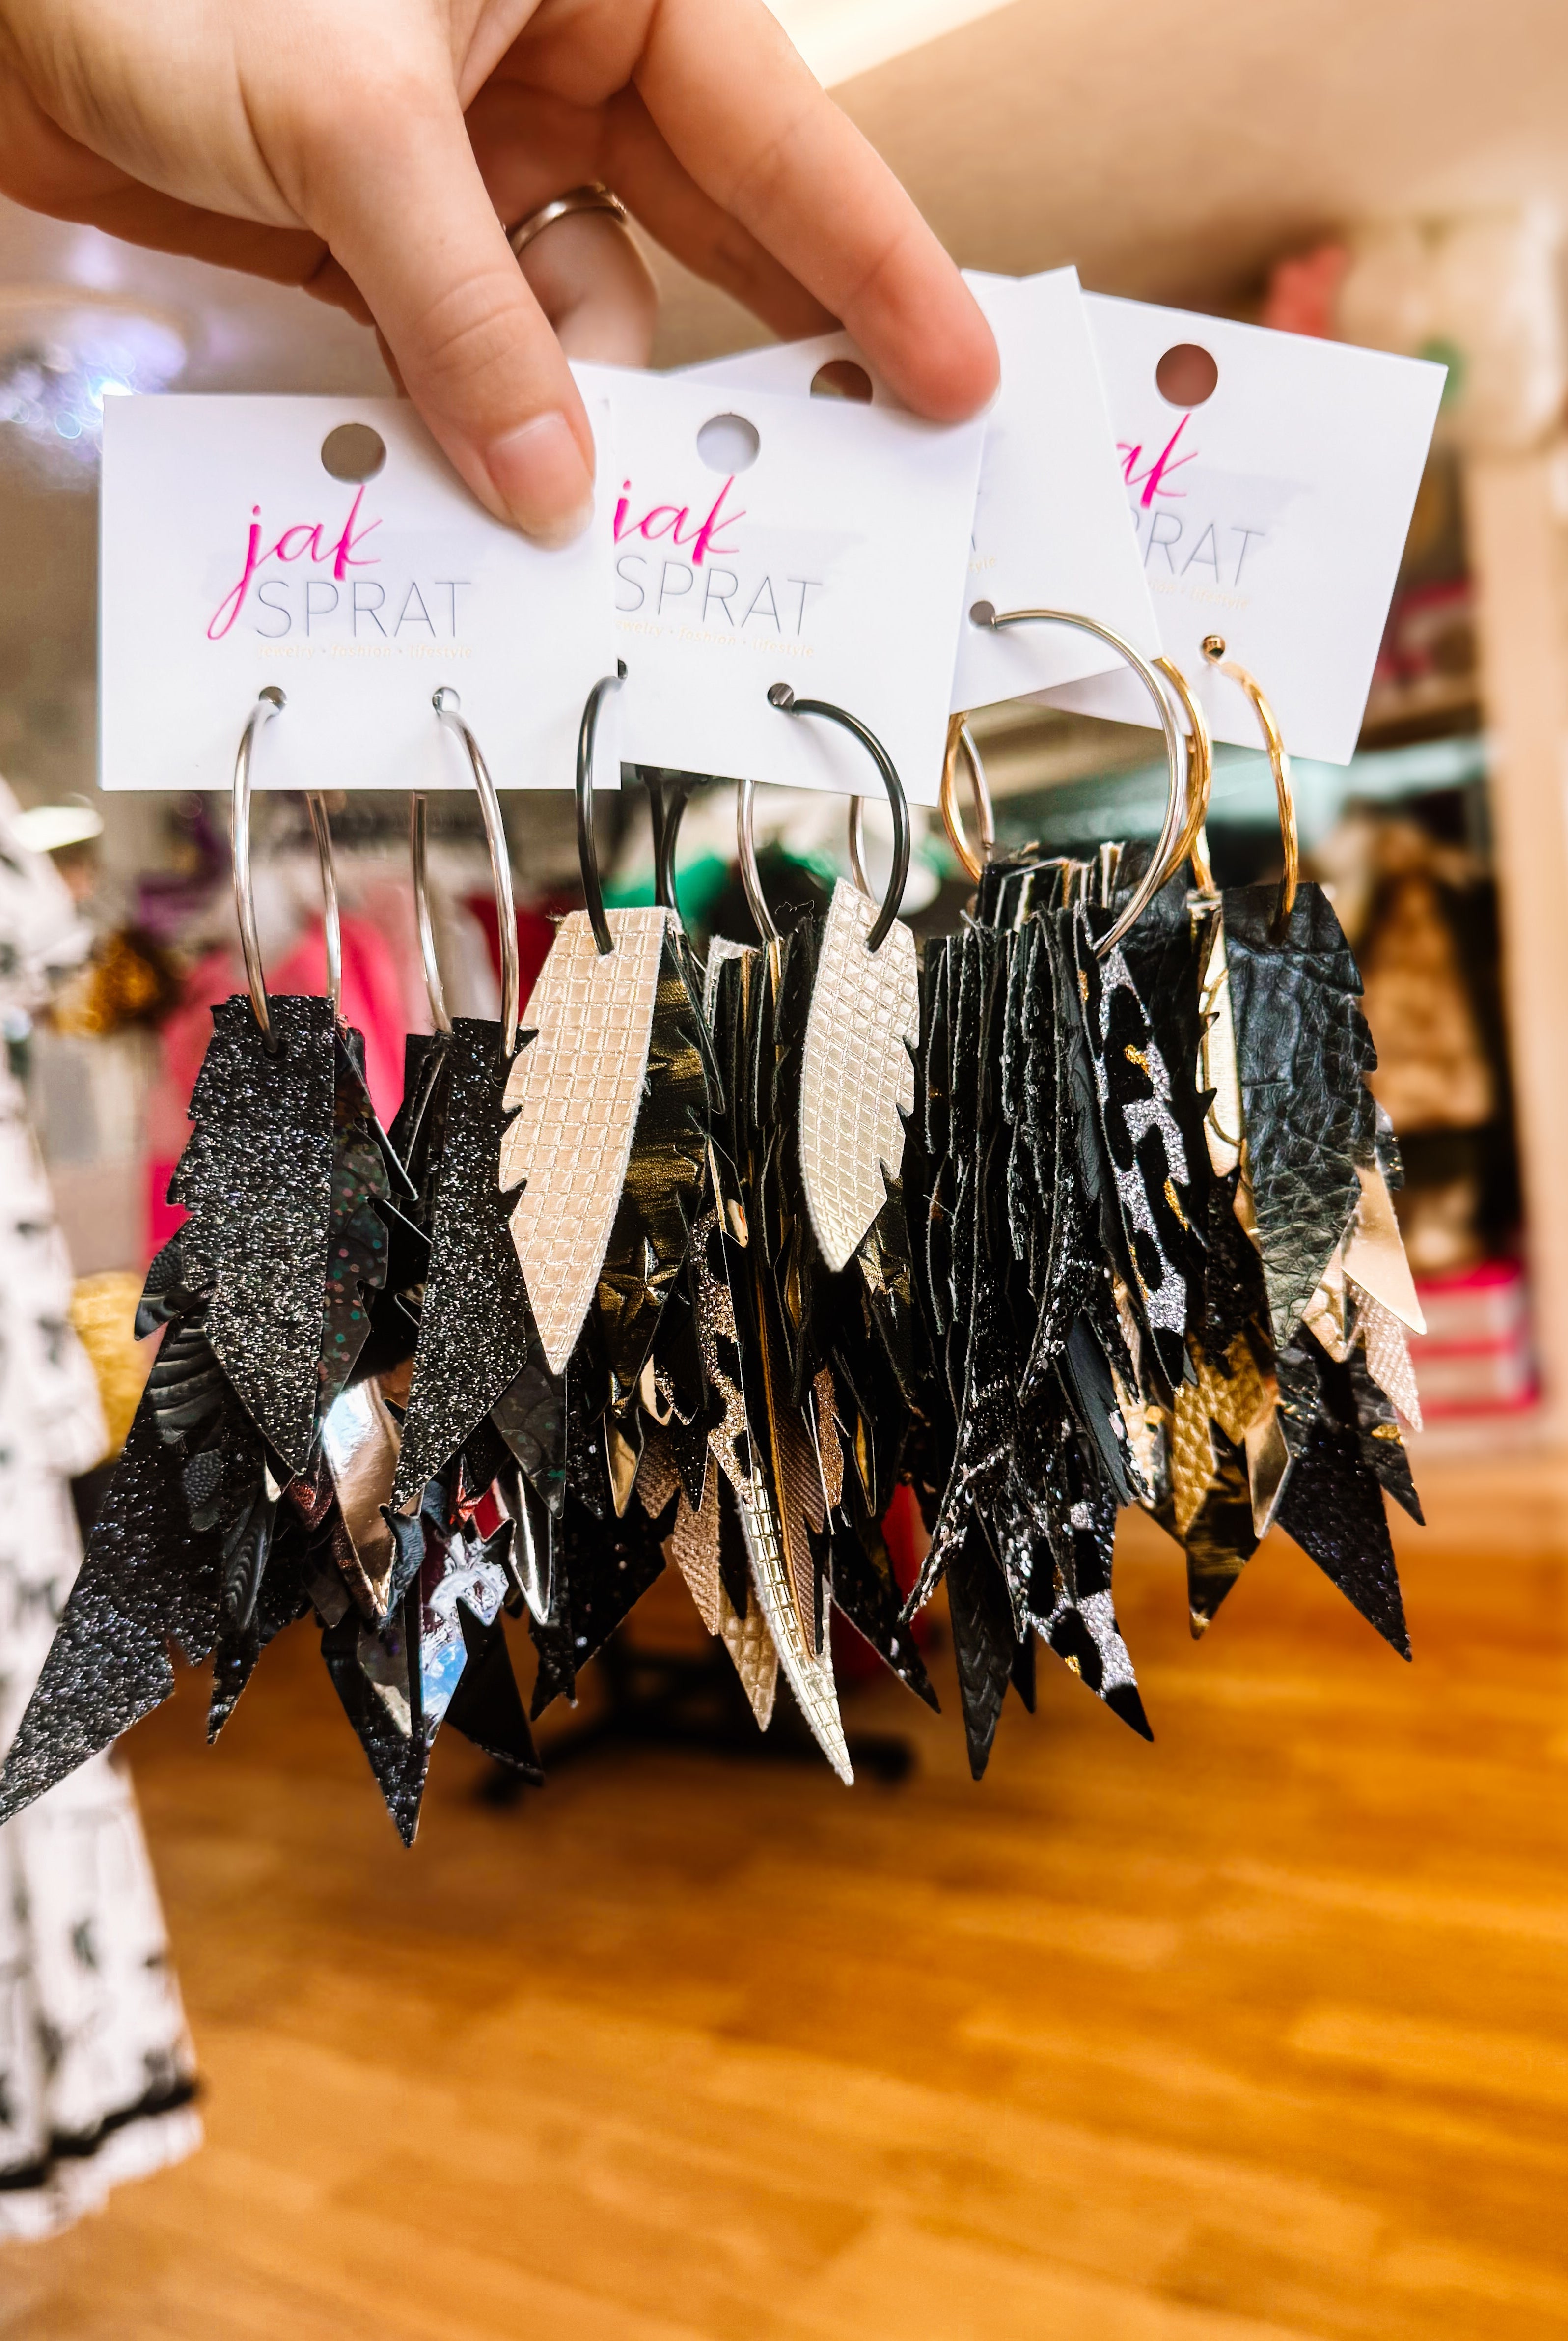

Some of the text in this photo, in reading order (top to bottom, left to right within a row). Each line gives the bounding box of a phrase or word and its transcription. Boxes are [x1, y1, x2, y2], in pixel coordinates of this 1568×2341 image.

[207, 485, 383, 640] jak
[257, 581, 471, 638] SPRAT
[615, 555, 824, 636] SPRAT
[258, 644, 472, 659] jewelry fashion lifestyle
[614, 619, 815, 657] ewelry fashion lifestyle
